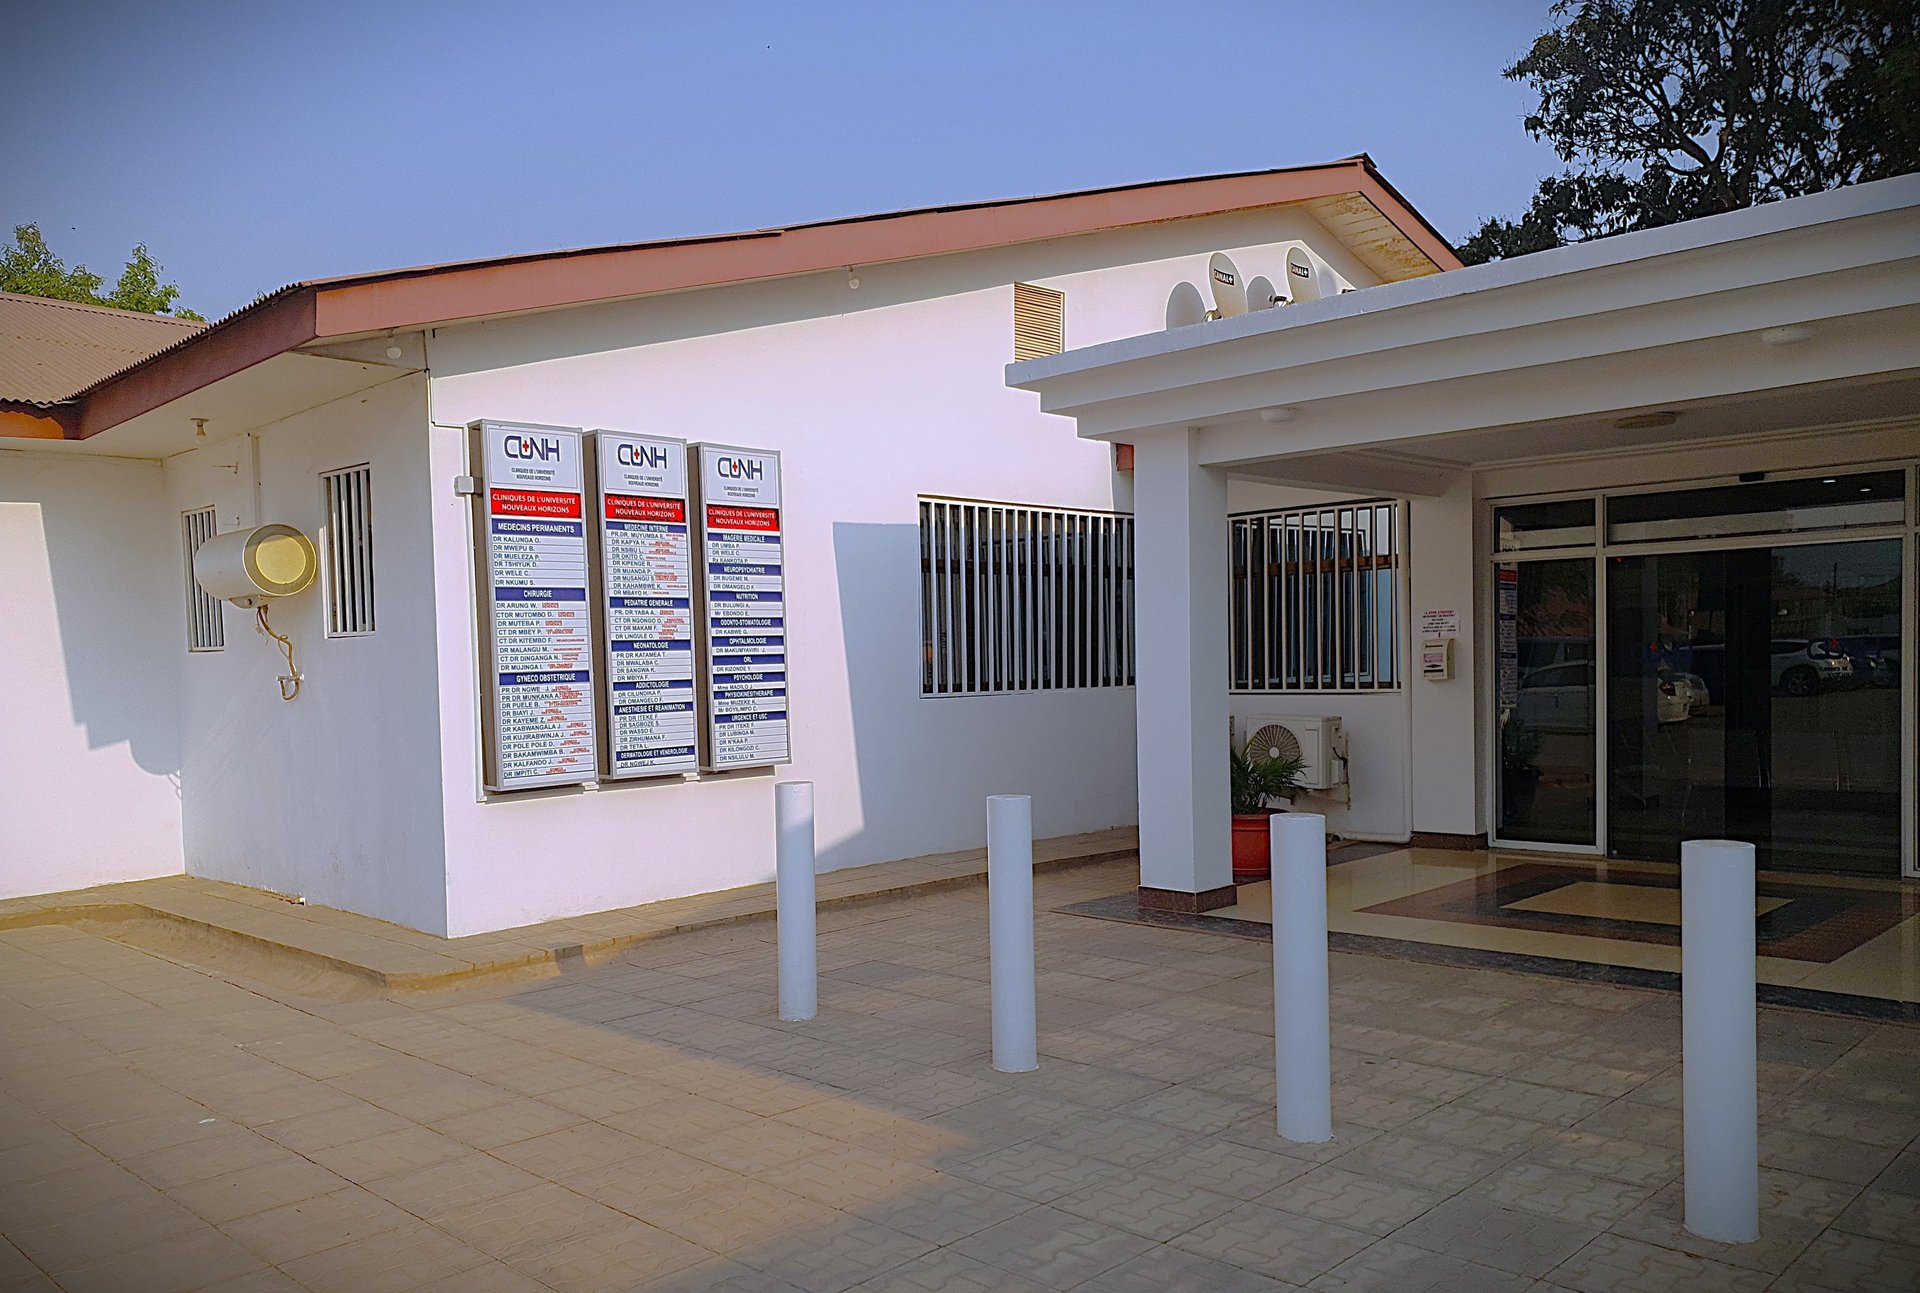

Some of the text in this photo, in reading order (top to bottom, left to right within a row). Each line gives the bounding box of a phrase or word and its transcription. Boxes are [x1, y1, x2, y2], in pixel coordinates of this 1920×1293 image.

[1214, 270, 1233, 284] CANAL+
[493, 494, 526, 502] CLINIQUES
[537, 496, 575, 504] L'UNIVERSITÉ
[608, 499, 636, 507] CLINIQUES
[538, 505, 569, 513] HORIZONS
[616, 508, 675, 518] NOUVEAUX HORIZONS
[498, 523, 574, 533] MEDECINS PERMANENTS
[524, 590, 552, 598] CHIRURGIE
[540, 673, 575, 681] OBSTETRIQUE
[513, 750, 557, 758] BAKAMWIMBA
[621, 750, 652, 758] DERMATOLOGIE
